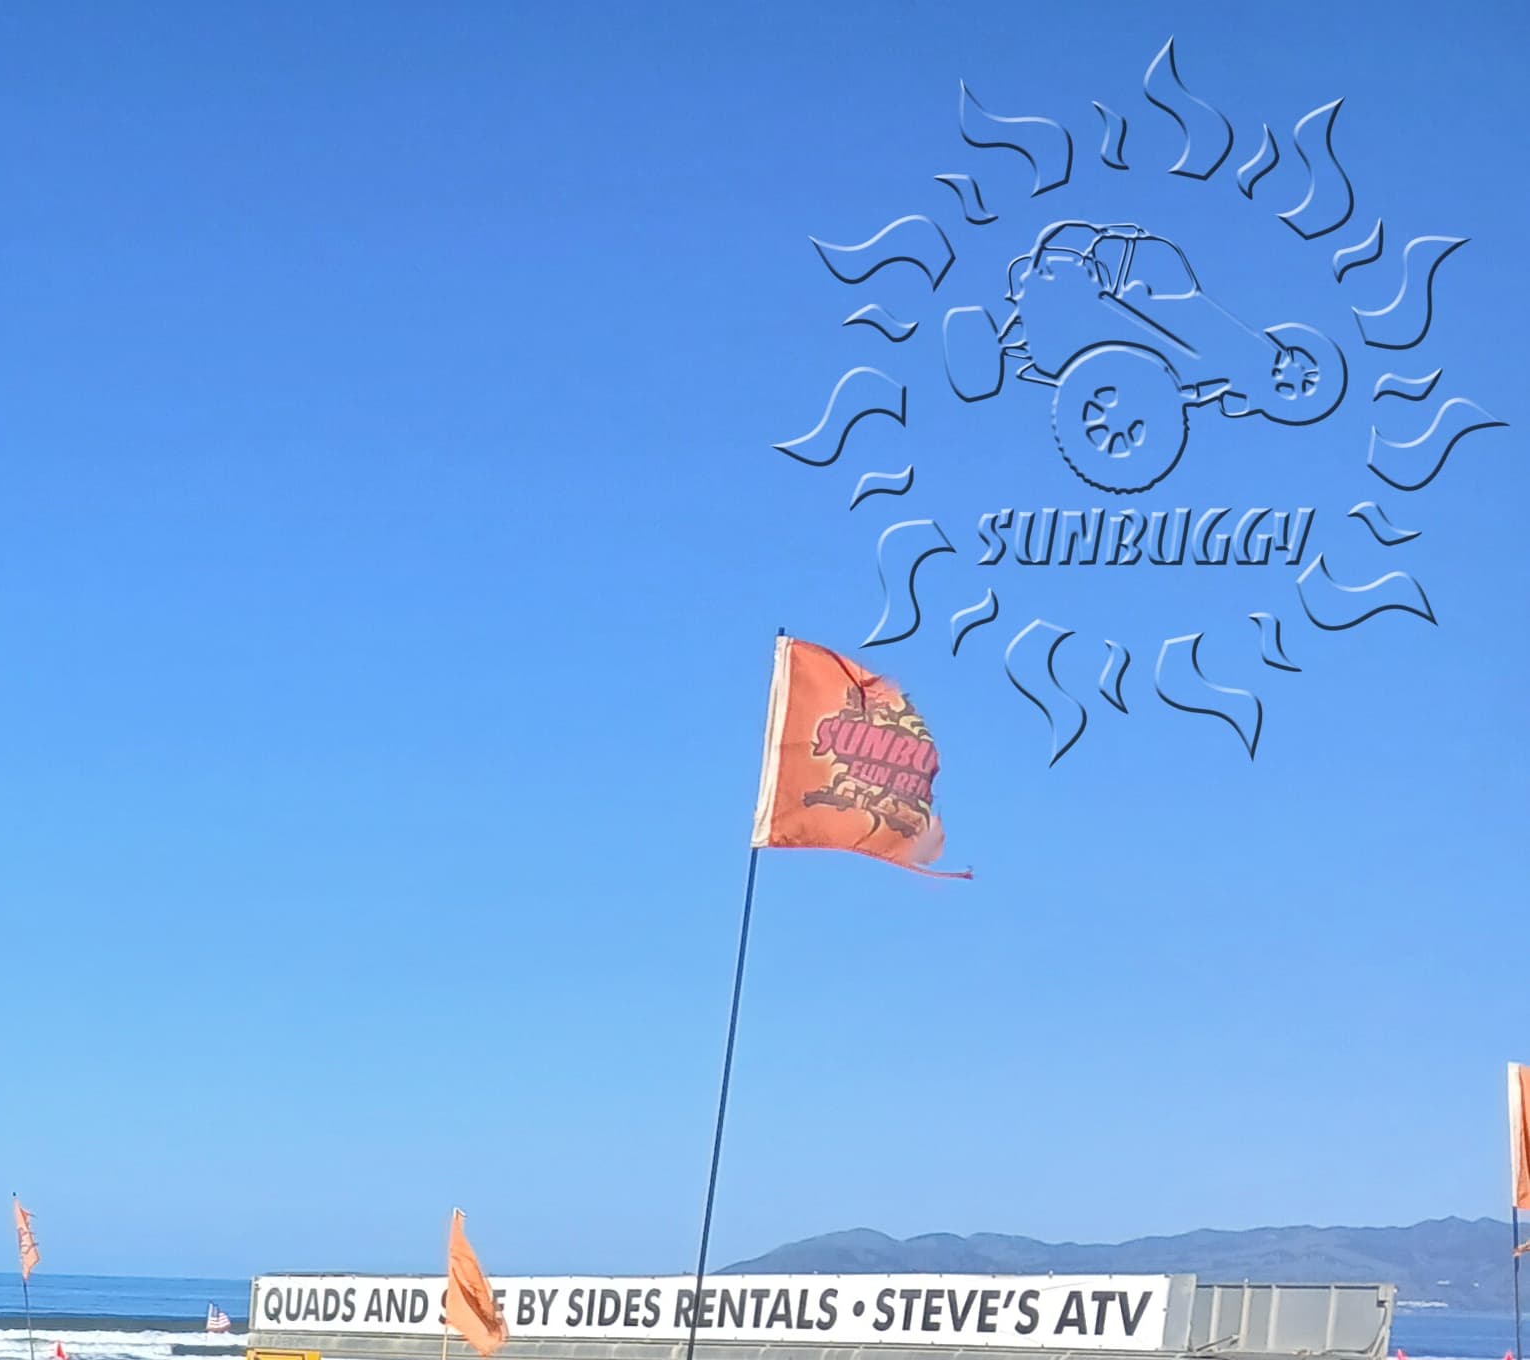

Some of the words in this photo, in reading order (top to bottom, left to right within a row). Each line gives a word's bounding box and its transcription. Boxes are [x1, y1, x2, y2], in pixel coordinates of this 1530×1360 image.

[814, 717, 940, 776] SUNBU
[892, 772, 932, 800] REN
[264, 1287, 356, 1324] QUADS
[364, 1288, 430, 1324] AND
[516, 1288, 559, 1326] BY
[565, 1288, 662, 1328] SIDES
[673, 1288, 839, 1331] RENTALS
[872, 1288, 1041, 1335] STEVE'S
[1053, 1290, 1153, 1336] ATV
